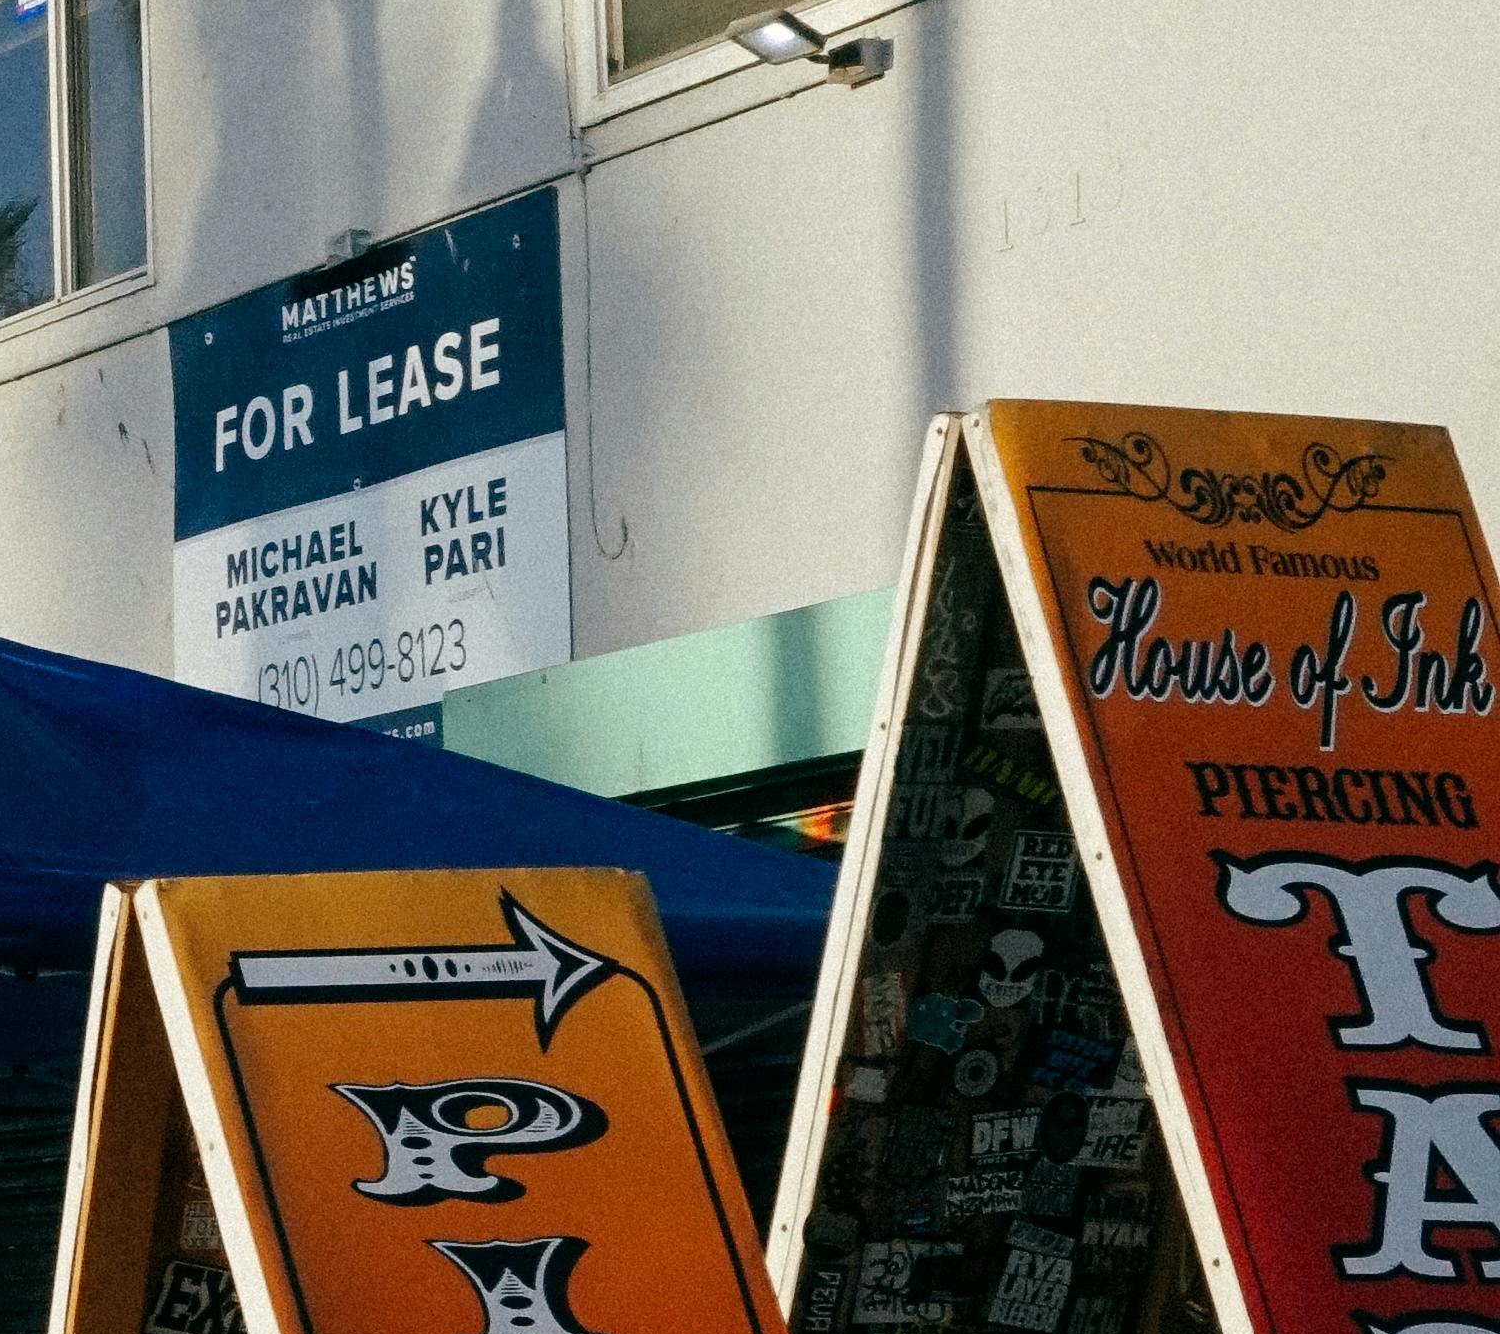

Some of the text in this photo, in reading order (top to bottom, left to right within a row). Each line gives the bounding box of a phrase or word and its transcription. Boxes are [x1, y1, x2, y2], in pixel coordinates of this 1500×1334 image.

[280, 259, 415, 332] MATTHEWS
[214, 317, 501, 472] FOR LEASE
[420, 477, 507, 536] KYLE
[226, 519, 364, 588] MICHAEL
[424, 527, 506, 585] PARI
[1143, 539, 1380, 581] World Famous
[216, 563, 378, 638] PAKRAVAN
[328, 618, 467, 696] 499-8123
[1086, 575, 1496, 752] House of Ink
[1185, 761, 1479, 829] PIERCING
[971, 1114, 1039, 1155] DFW
